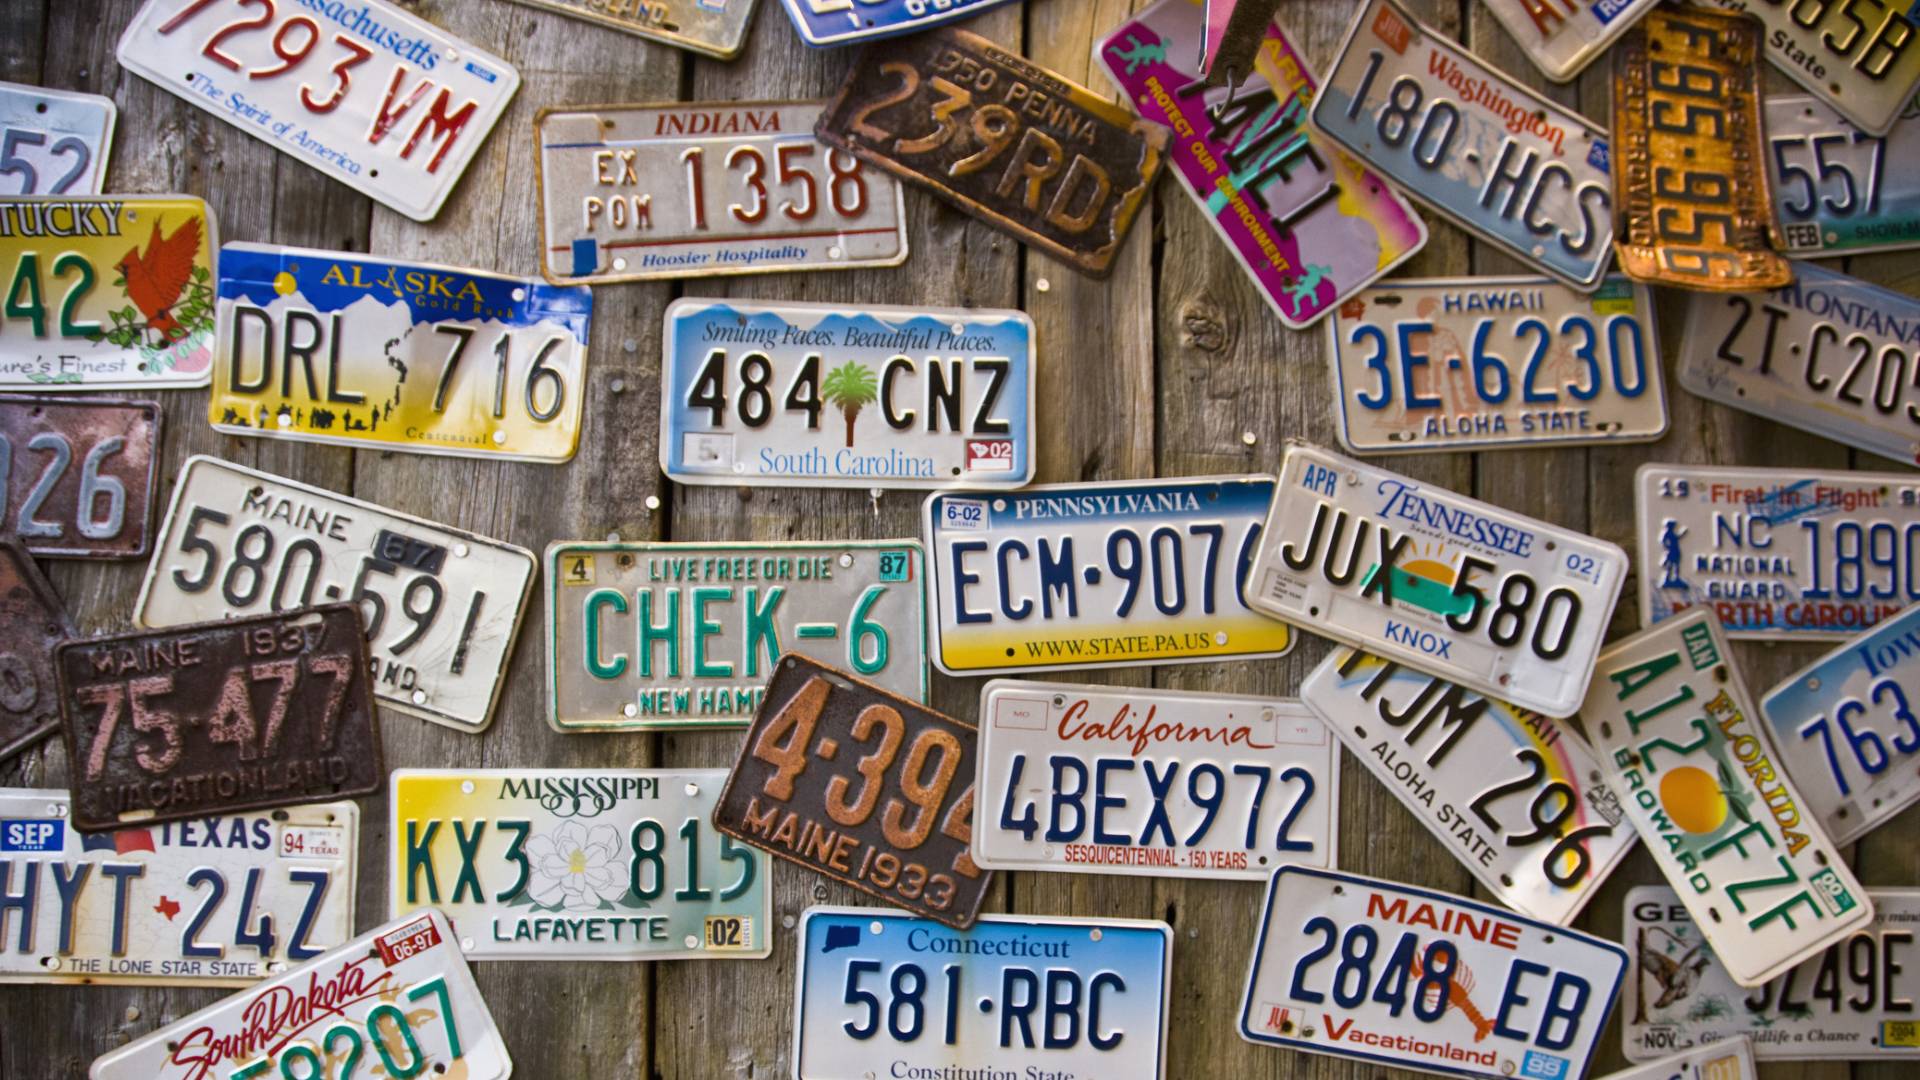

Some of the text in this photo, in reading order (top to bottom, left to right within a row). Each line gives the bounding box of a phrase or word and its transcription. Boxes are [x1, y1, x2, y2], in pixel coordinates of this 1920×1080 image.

[300, 0, 440, 70] sachusetts
[1770, 30, 1828, 79] State
[369, 65, 479, 174] VM
[1004, 81, 1098, 147] PENNA
[1428, 49, 1566, 156] Washington
[192, 72, 361, 175] The Spirit of America
[655, 110, 781, 136] INDIANA
[852, 62, 1112, 236] 239RD
[1348, 51, 1610, 256] 180-HCS
[593, 150, 638, 186] EX
[1144, 75, 1290, 275] PROTECT OUR ENVIRONMENT
[1772, 132, 1888, 219] 557
[681, 145, 868, 231] 1358
[585, 196, 652, 232] POW
[1786, 225, 1820, 248] FEB
[642, 244, 808, 268] Hoosier Hospitality
[321, 264, 485, 303] ALASKA
[415, 294, 460, 312] Gold
[1443, 290, 1545, 314] HAWAII
[701, 321, 998, 353] Smiling Faces. Beautiful Places.
[58, 355, 127, 373] Finest
[229, 304, 565, 424] DRL 716
[1350, 315, 1647, 411] 3E-6230
[687, 348, 1011, 434] 484 CNZ
[406, 427, 487, 445] Centennial
[1425, 410, 1592, 438] ALOHA STATE
[759, 446, 936, 478] South Carolina
[989, 441, 1012, 459] 02
[0, 431, 127, 539] 26
[1302, 463, 1339, 498] APR
[1711, 484, 1765, 505] First
[1815, 487, 1880, 512] Flight
[241, 487, 352, 542] MAINE
[946, 505, 982, 522] 6-02
[1015, 492, 1201, 520] PENNSYLVANIA
[1375, 479, 1536, 560] TENNESSEE
[1713, 512, 1773, 549] NC
[570, 557, 588, 579] 4
[648, 556, 833, 581] LIVE FREE OR DIE
[880, 555, 906, 574] 87
[1281, 503, 1582, 662] JUX 580
[1566, 553, 1595, 576] 02
[1696, 555, 1797, 577] NATIONAL
[1707, 581, 1787, 600] GUARD
[583, 584, 889, 680] CHEK-6
[1671, 602, 1774, 627] RTH
[88, 638, 202, 678] MAINE
[1025, 633, 1211, 659] WWW.STATE.PA.US
[1385, 620, 1453, 660] KNOX
[1684, 625, 1719, 671] JAN
[637, 687, 691, 717] NEW
[1057, 699, 1276, 758] California
[1801, 679, 1920, 796] 763
[1704, 689, 1811, 858] FLORIDA
[499, 776, 660, 818] MISSISSIPPI
[999, 754, 1316, 852] 4BEX972
[1371, 740, 1499, 869] ALOHA STATE
[1609, 650, 1825, 934] A12 FZF
[8, 823, 55, 845] SEP
[160, 817, 272, 849] TEXAS
[1469, 749, 1613, 888] 296
[1613, 747, 1712, 895] BROWARD
[284, 833, 305, 853] 94
[309, 846, 339, 856] TEXAS
[405, 818, 755, 904] KX3 815
[740, 797, 958, 911] MAINE 1933
[1064, 844, 1179, 868] SESQUICENTENNIAL
[1187, 851, 1208, 868] 150
[1210, 852, 1248, 870] YEARS
[0, 860, 330, 959] HYT 24Z
[1366, 894, 1522, 951] MAINE
[391, 929, 437, 962] 06-97
[493, 916, 669, 943] LAFAYETTE
[712, 918, 741, 946] 02
[907, 926, 1073, 960] Connecticut
[69, 958, 258, 977] THE LONE STAR STATE
[1289, 916, 1592, 1052] 2848 EB
[229, 976, 463, 1080] 207
[1323, 1014, 1497, 1067] Vacationland
[1644, 1031, 1677, 1049] NOV
[1793, 1033, 1803, 1043] a
[1807, 1030, 1861, 1043] Chance
[890, 1059, 1075, 1080] Constitution State
[1527, 1059, 1560, 1078] 99
